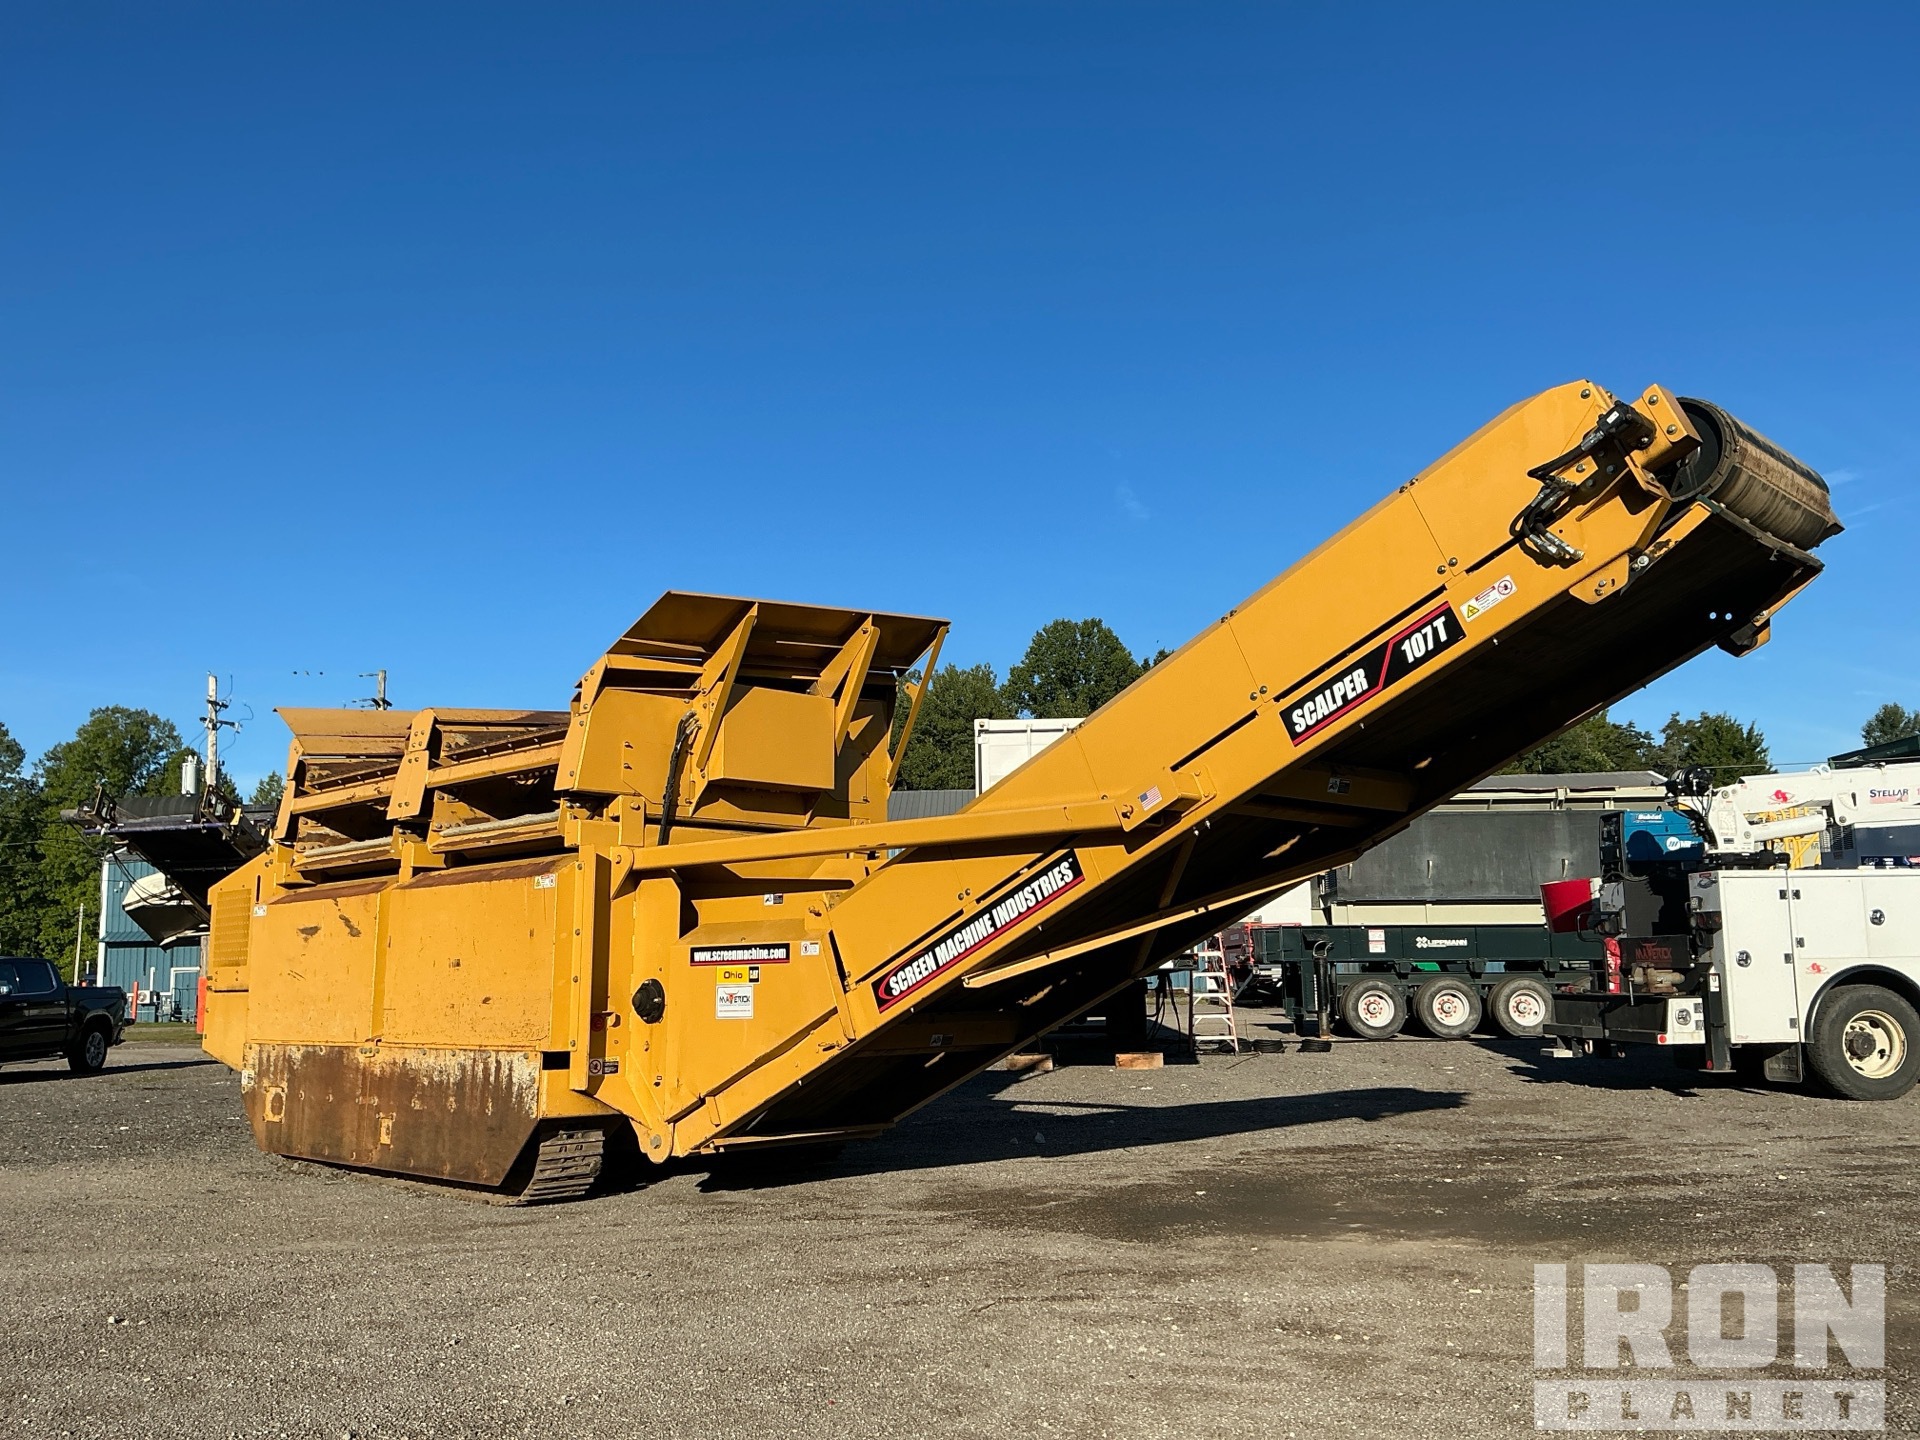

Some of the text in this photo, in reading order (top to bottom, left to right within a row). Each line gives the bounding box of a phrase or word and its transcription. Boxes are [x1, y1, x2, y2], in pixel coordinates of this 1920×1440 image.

[1291, 616, 1449, 733] SCALPER 107T
[1869, 788, 1909, 798] STELLAR
[889, 861, 1074, 996] SCREEN MACHINE INDUSTRIES
[1427, 939, 1467, 947] LIPPMANN
[693, 946, 787, 962] www.screenmachine.com
[723, 970, 743, 979] Ohio
[719, 995, 751, 1004] MAVERICK
